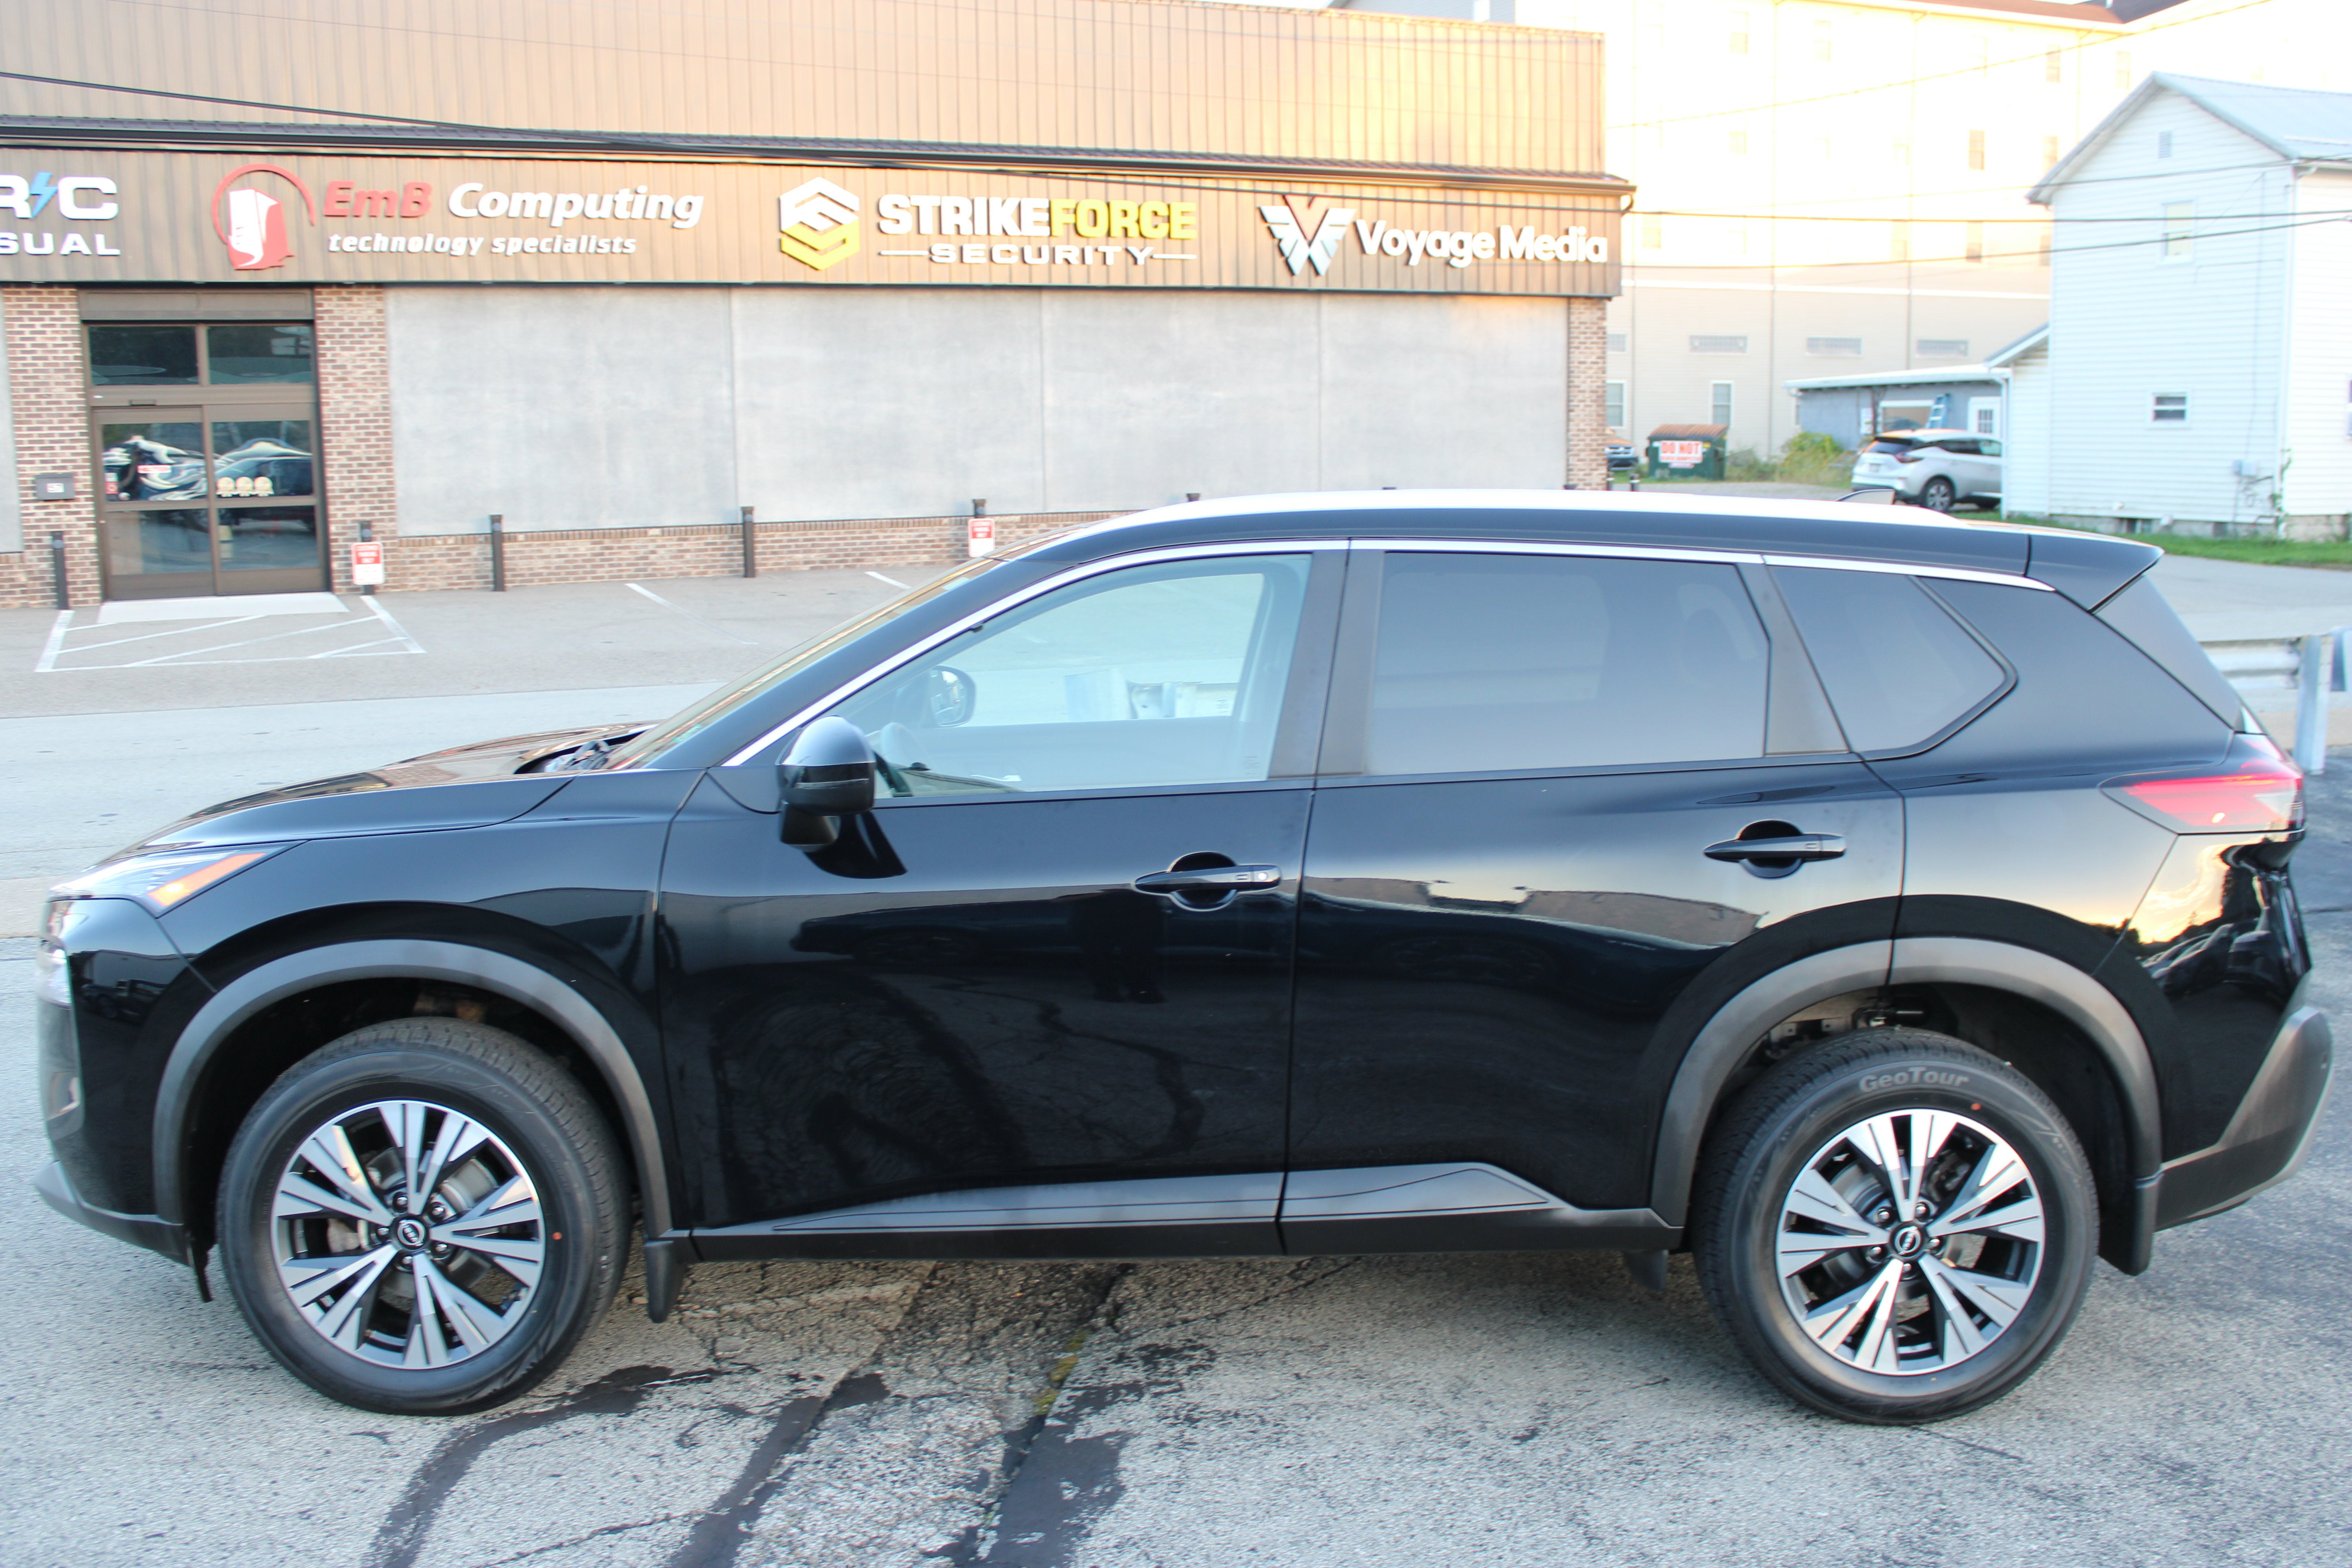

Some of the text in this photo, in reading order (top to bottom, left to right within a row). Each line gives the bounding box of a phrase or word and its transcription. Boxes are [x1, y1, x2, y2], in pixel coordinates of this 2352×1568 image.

[323, 180, 704, 229] EmB Computing
[878, 194, 1197, 240] STRIKEFORCE
[328, 233, 637, 256] technology specialists
[929, 243, 1155, 265] SECURITY
[1354, 219, 1608, 268] Voyage Media
[1858, 1066, 1970, 1092] GeoTour
